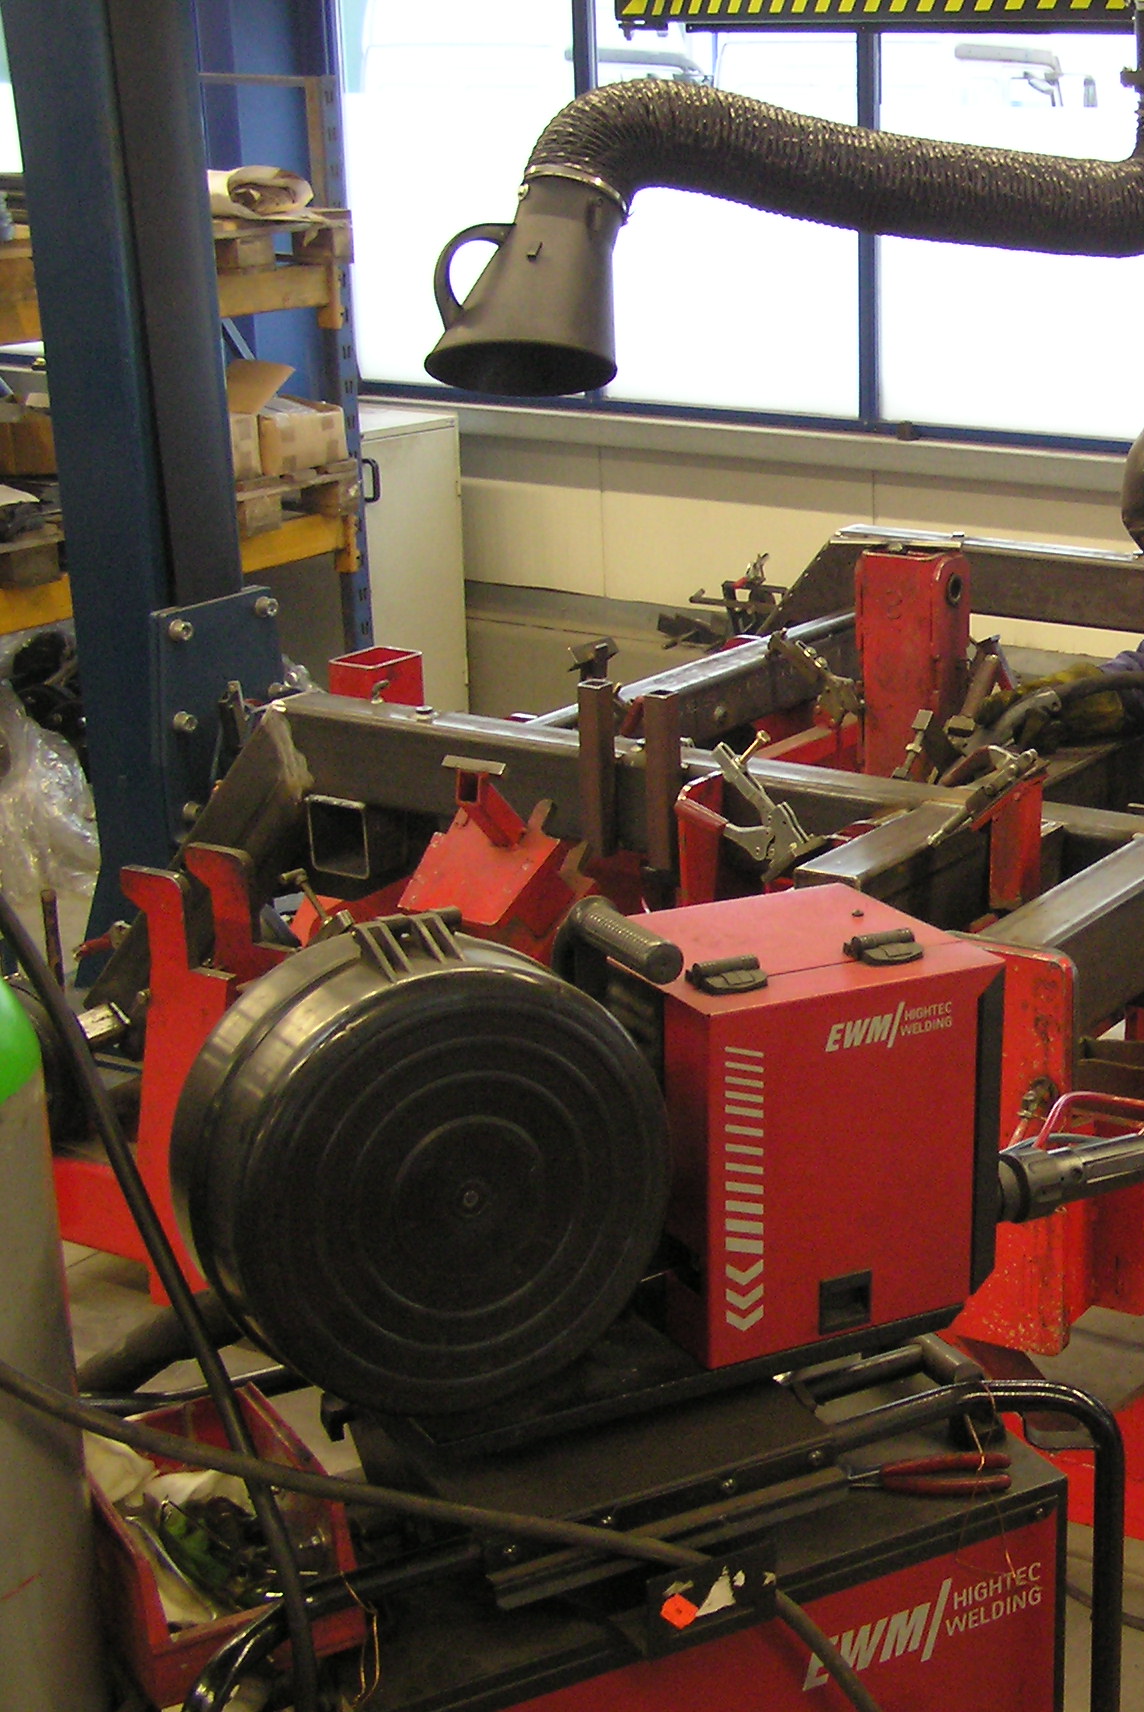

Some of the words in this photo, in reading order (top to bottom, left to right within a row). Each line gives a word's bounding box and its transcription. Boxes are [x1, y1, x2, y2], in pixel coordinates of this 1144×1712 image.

[900, 1016, 953, 1036] WELDING
[904, 1001, 953, 1021] HIGHTEC
[953, 1562, 1042, 1610] HIGHTEC
[945, 1585, 1042, 1637] WELDING
